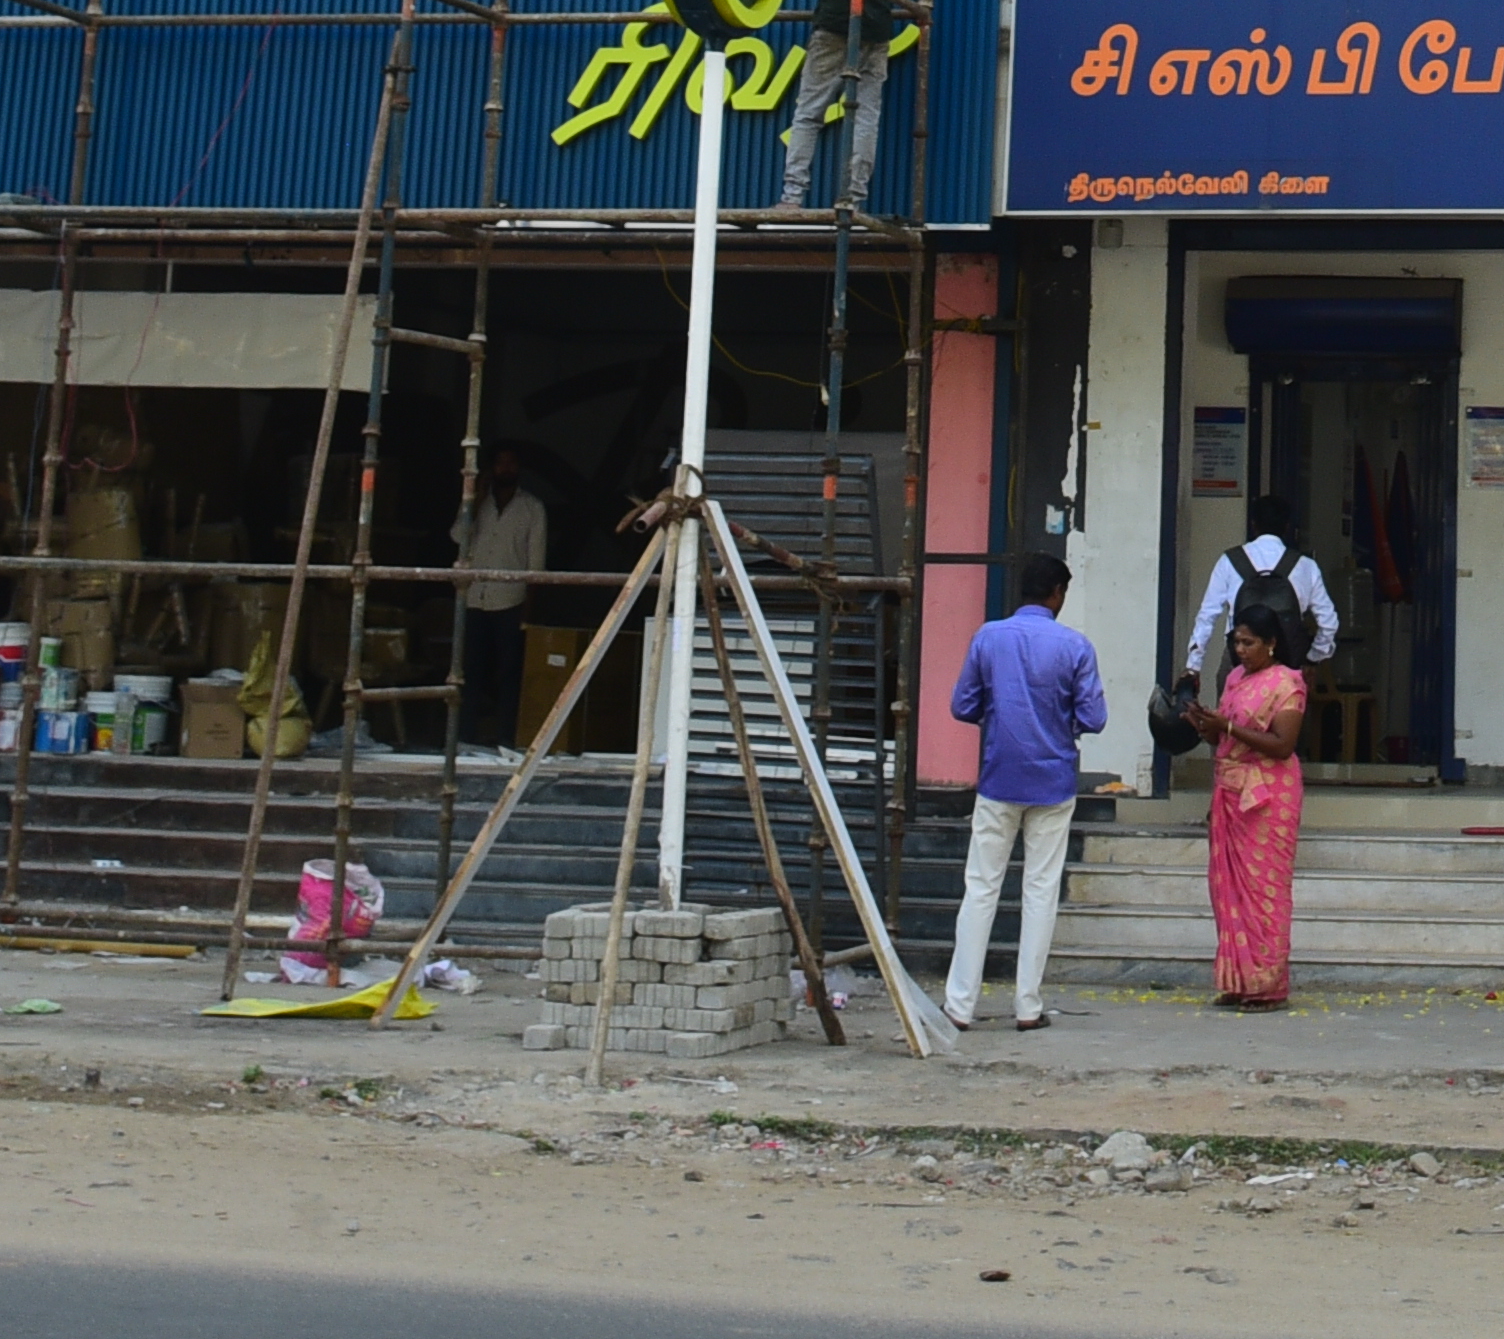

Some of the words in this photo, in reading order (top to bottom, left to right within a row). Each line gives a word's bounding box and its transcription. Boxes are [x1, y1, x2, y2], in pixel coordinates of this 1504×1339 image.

[1071, 23, 1138, 95] சி
[1149, 27, 1292, 96] எஸ்
[1307, 21, 1380, 95] பி
[1067, 170, 1248, 203] திருநெல்வேலி
[1258, 170, 1330, 196] கிளை
